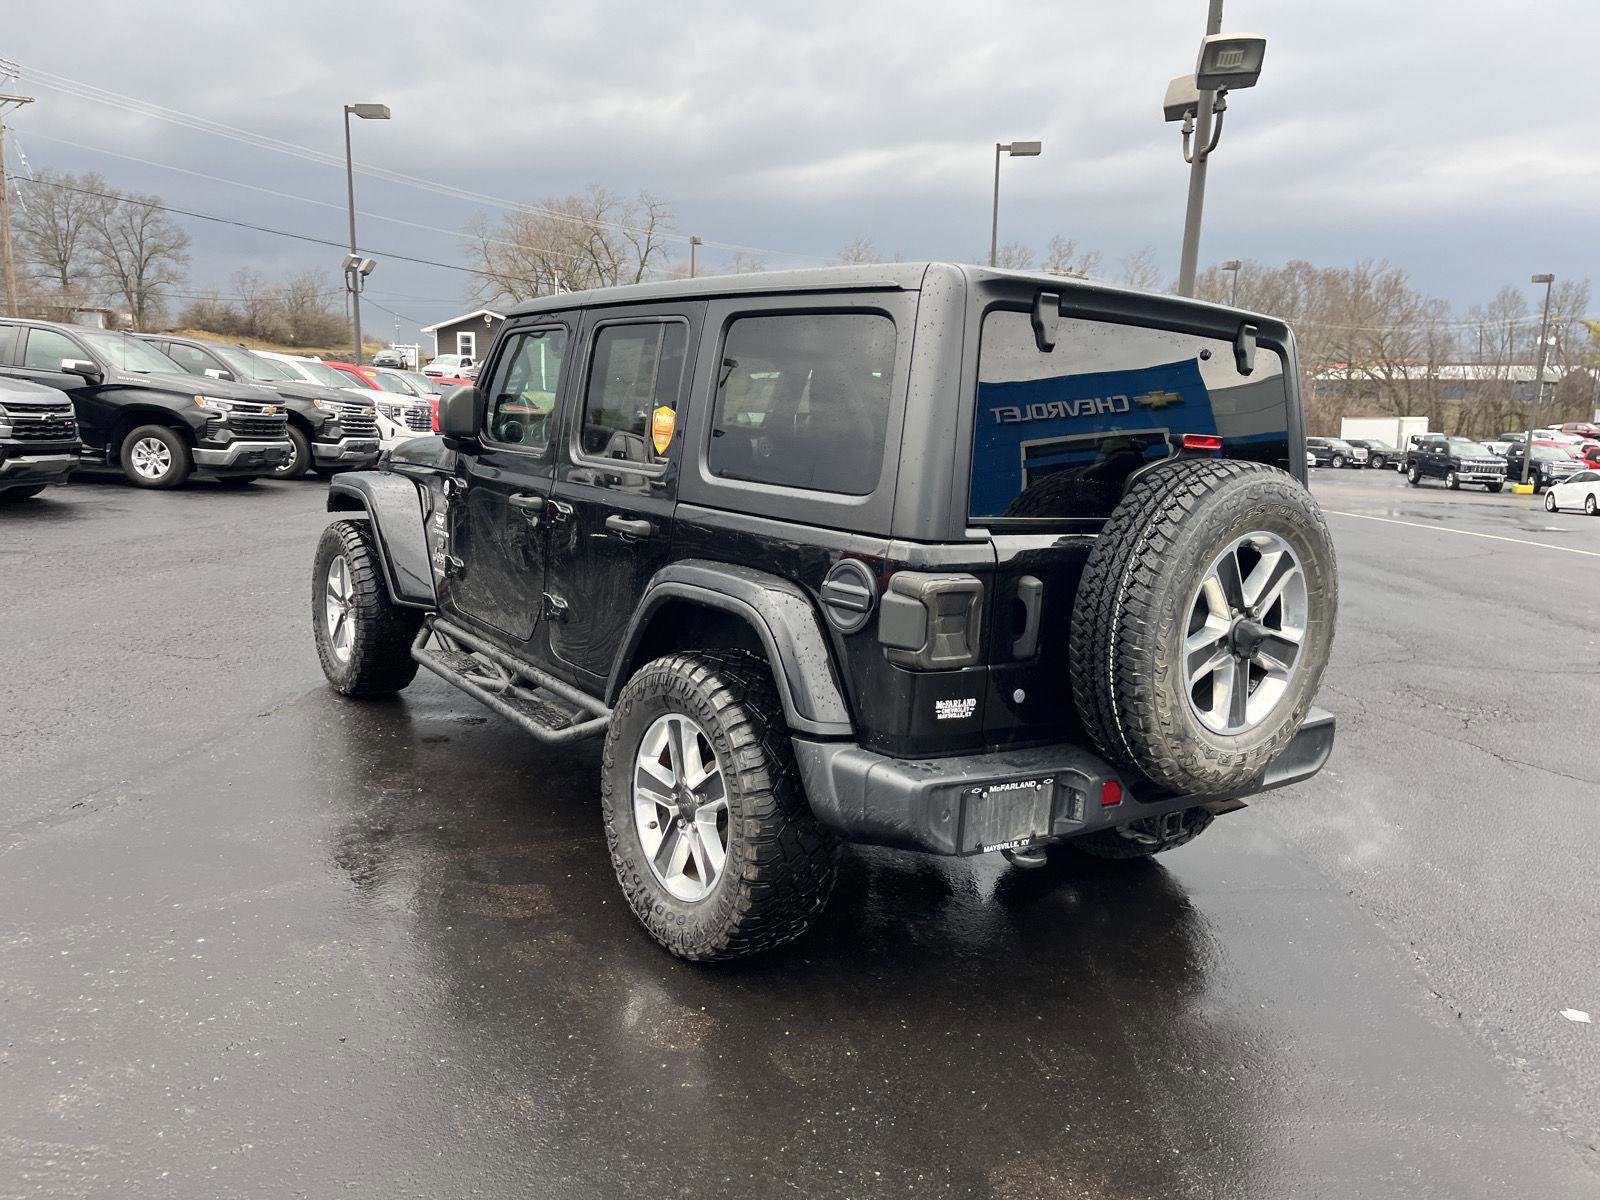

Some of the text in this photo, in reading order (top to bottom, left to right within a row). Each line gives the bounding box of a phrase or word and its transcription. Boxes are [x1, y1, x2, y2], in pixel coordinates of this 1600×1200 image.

[935, 698, 977, 709] McFARLAND
[989, 780, 1037, 793] McFARLAND
[1020, 838, 1030, 847] KY
